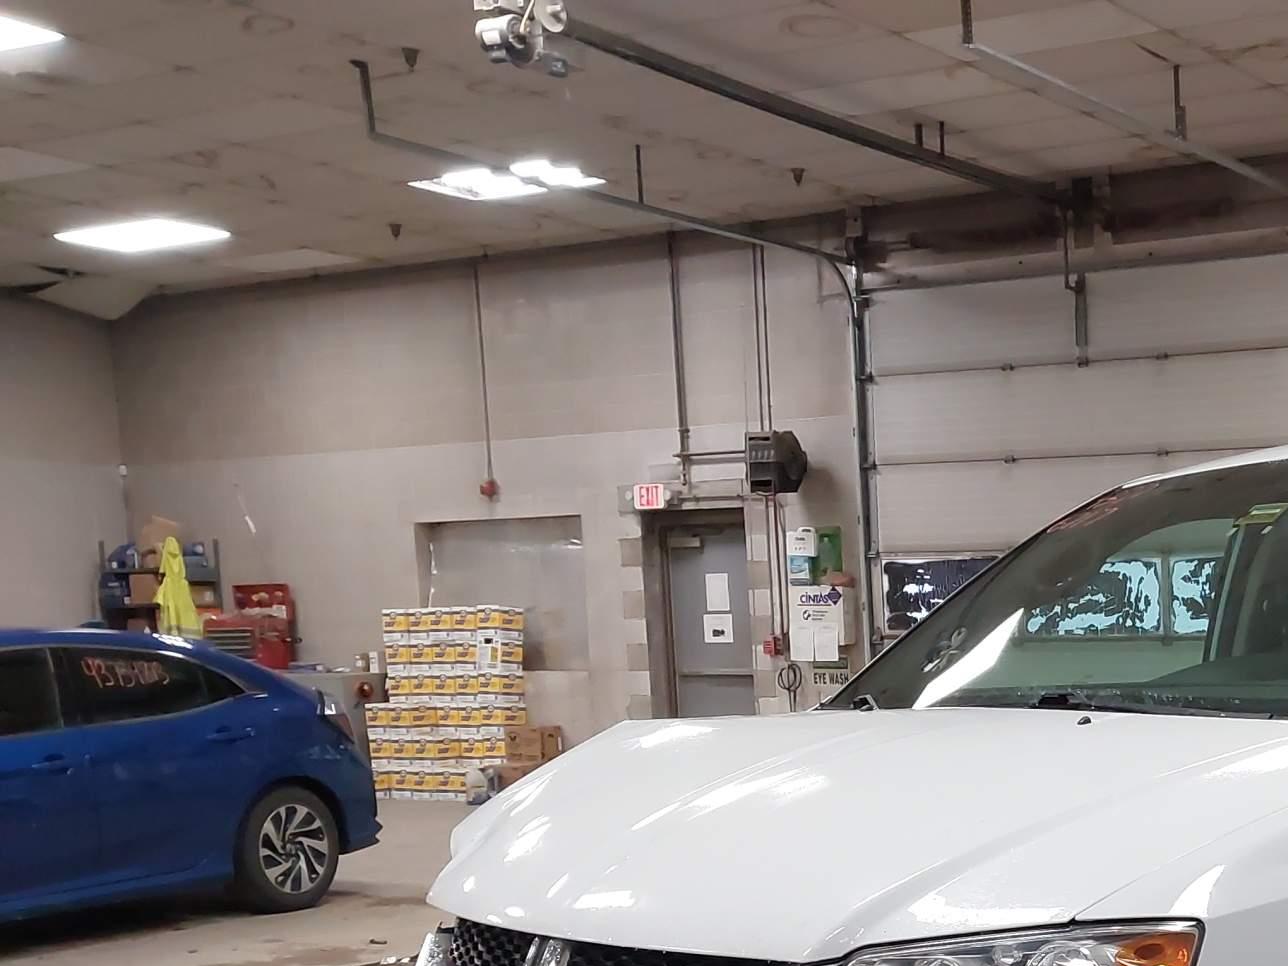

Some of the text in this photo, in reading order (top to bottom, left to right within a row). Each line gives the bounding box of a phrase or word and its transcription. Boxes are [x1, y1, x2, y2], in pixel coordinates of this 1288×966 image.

[640, 486, 659, 506] EXIT
[813, 672, 849, 685] EYE WASH
